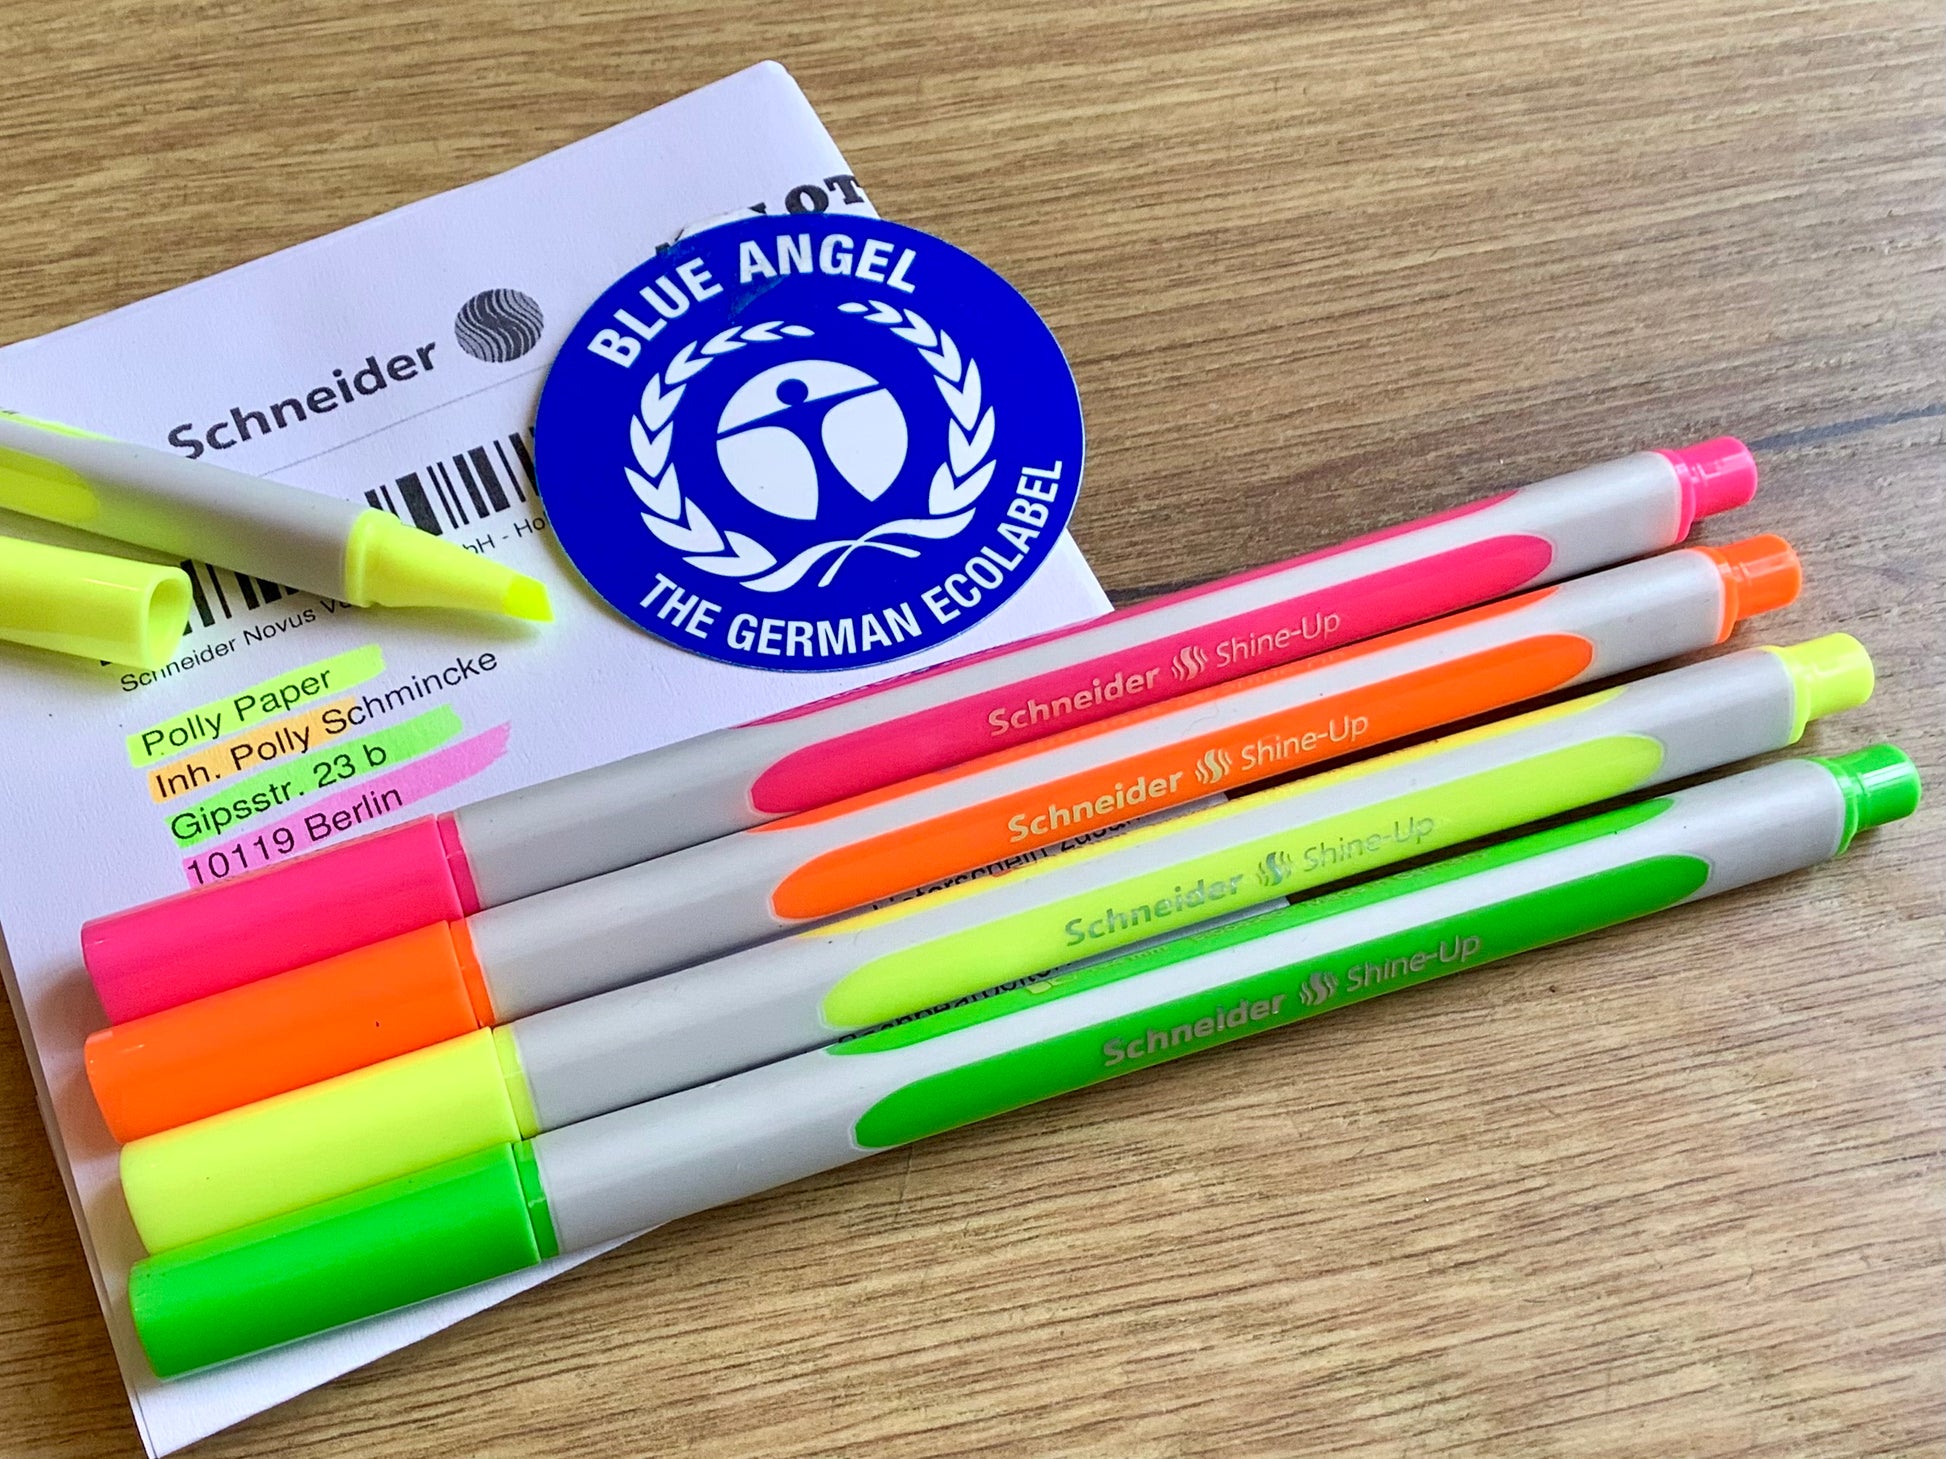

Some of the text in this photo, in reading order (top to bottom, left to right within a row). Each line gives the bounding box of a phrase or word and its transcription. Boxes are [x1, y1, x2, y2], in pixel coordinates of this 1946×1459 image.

[587, 232, 917, 369] BLUE ANGEL
[167, 341, 437, 460] Schneider
[243, 608, 316, 646] Novus
[513, 511, 546, 538] Ho
[639, 460, 1063, 657] THE GERMAN ECOLABEL
[141, 668, 331, 757] Polly Paper
[156, 651, 499, 799] Inh. Polly Schmincke
[988, 661, 1161, 738] Schneider
[1216, 610, 1341, 667] Shine-Up
[170, 743, 388, 841] Gipsstr. 23 b
[187, 787, 403, 886] 10119 Berlin
[1007, 768, 1183, 843] Schneider
[1241, 712, 1370, 771] Shine-Up
[1065, 870, 1245, 946] Schneider
[1303, 814, 1437, 872] Shine-Up
[1103, 993, 1286, 1069] Schneider
[1345, 932, 1483, 993] Shine-Up
